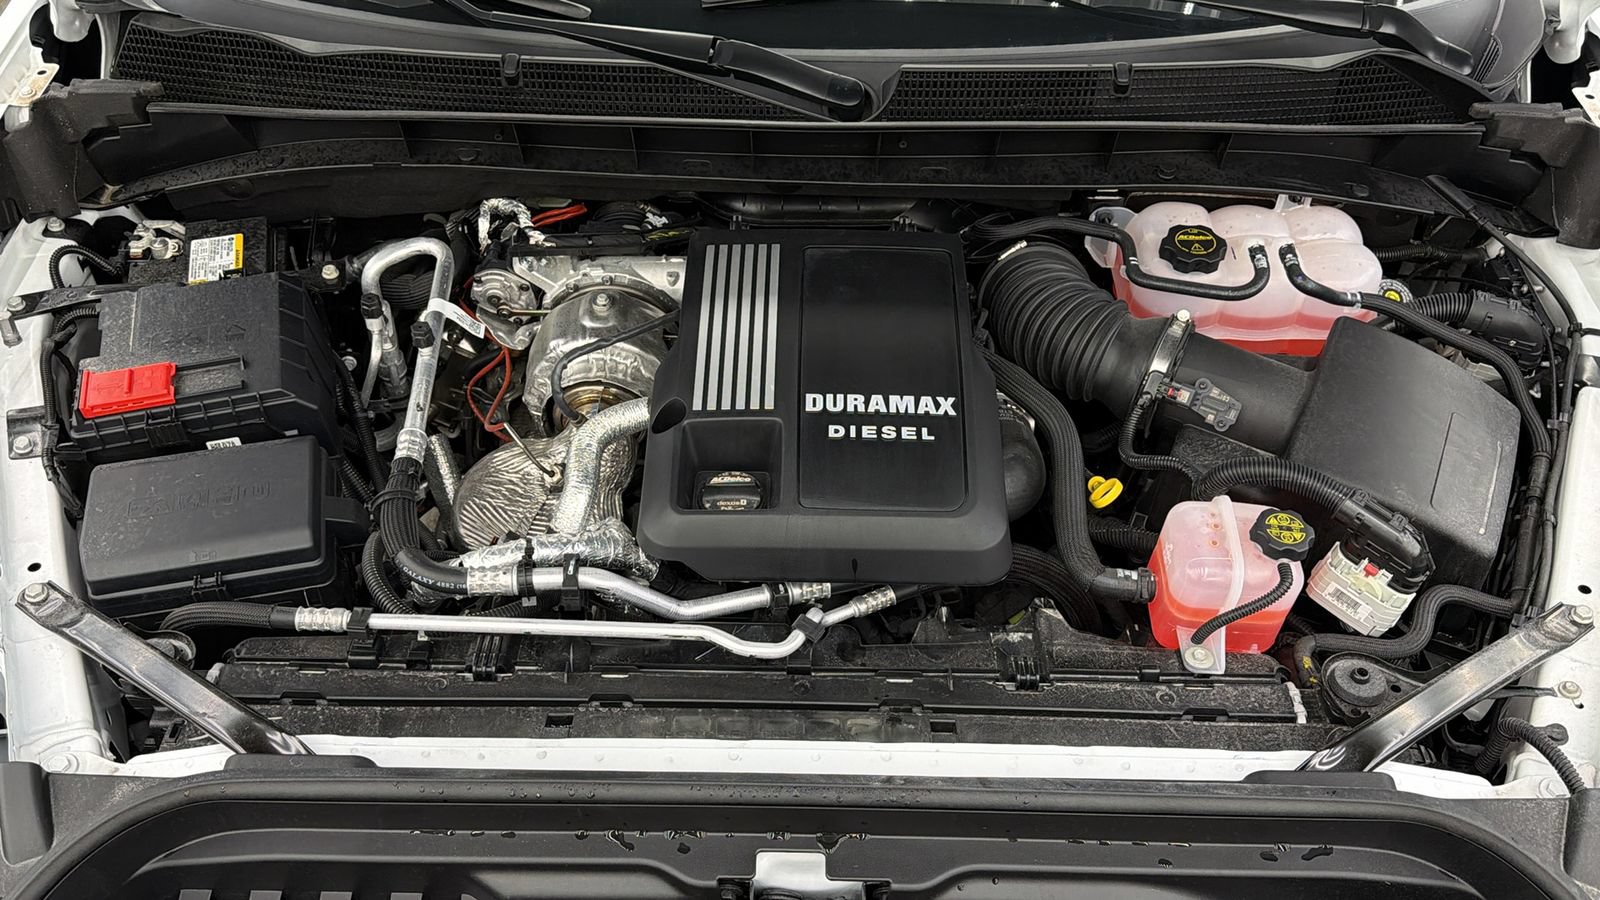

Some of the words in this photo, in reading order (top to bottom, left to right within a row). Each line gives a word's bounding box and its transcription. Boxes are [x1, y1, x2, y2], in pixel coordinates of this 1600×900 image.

[805, 393, 957, 416] DURAMAX
[828, 425, 935, 440] DIESEL
[710, 476, 752, 484] ACDelco
[402, 566, 435, 585] GALAXY
